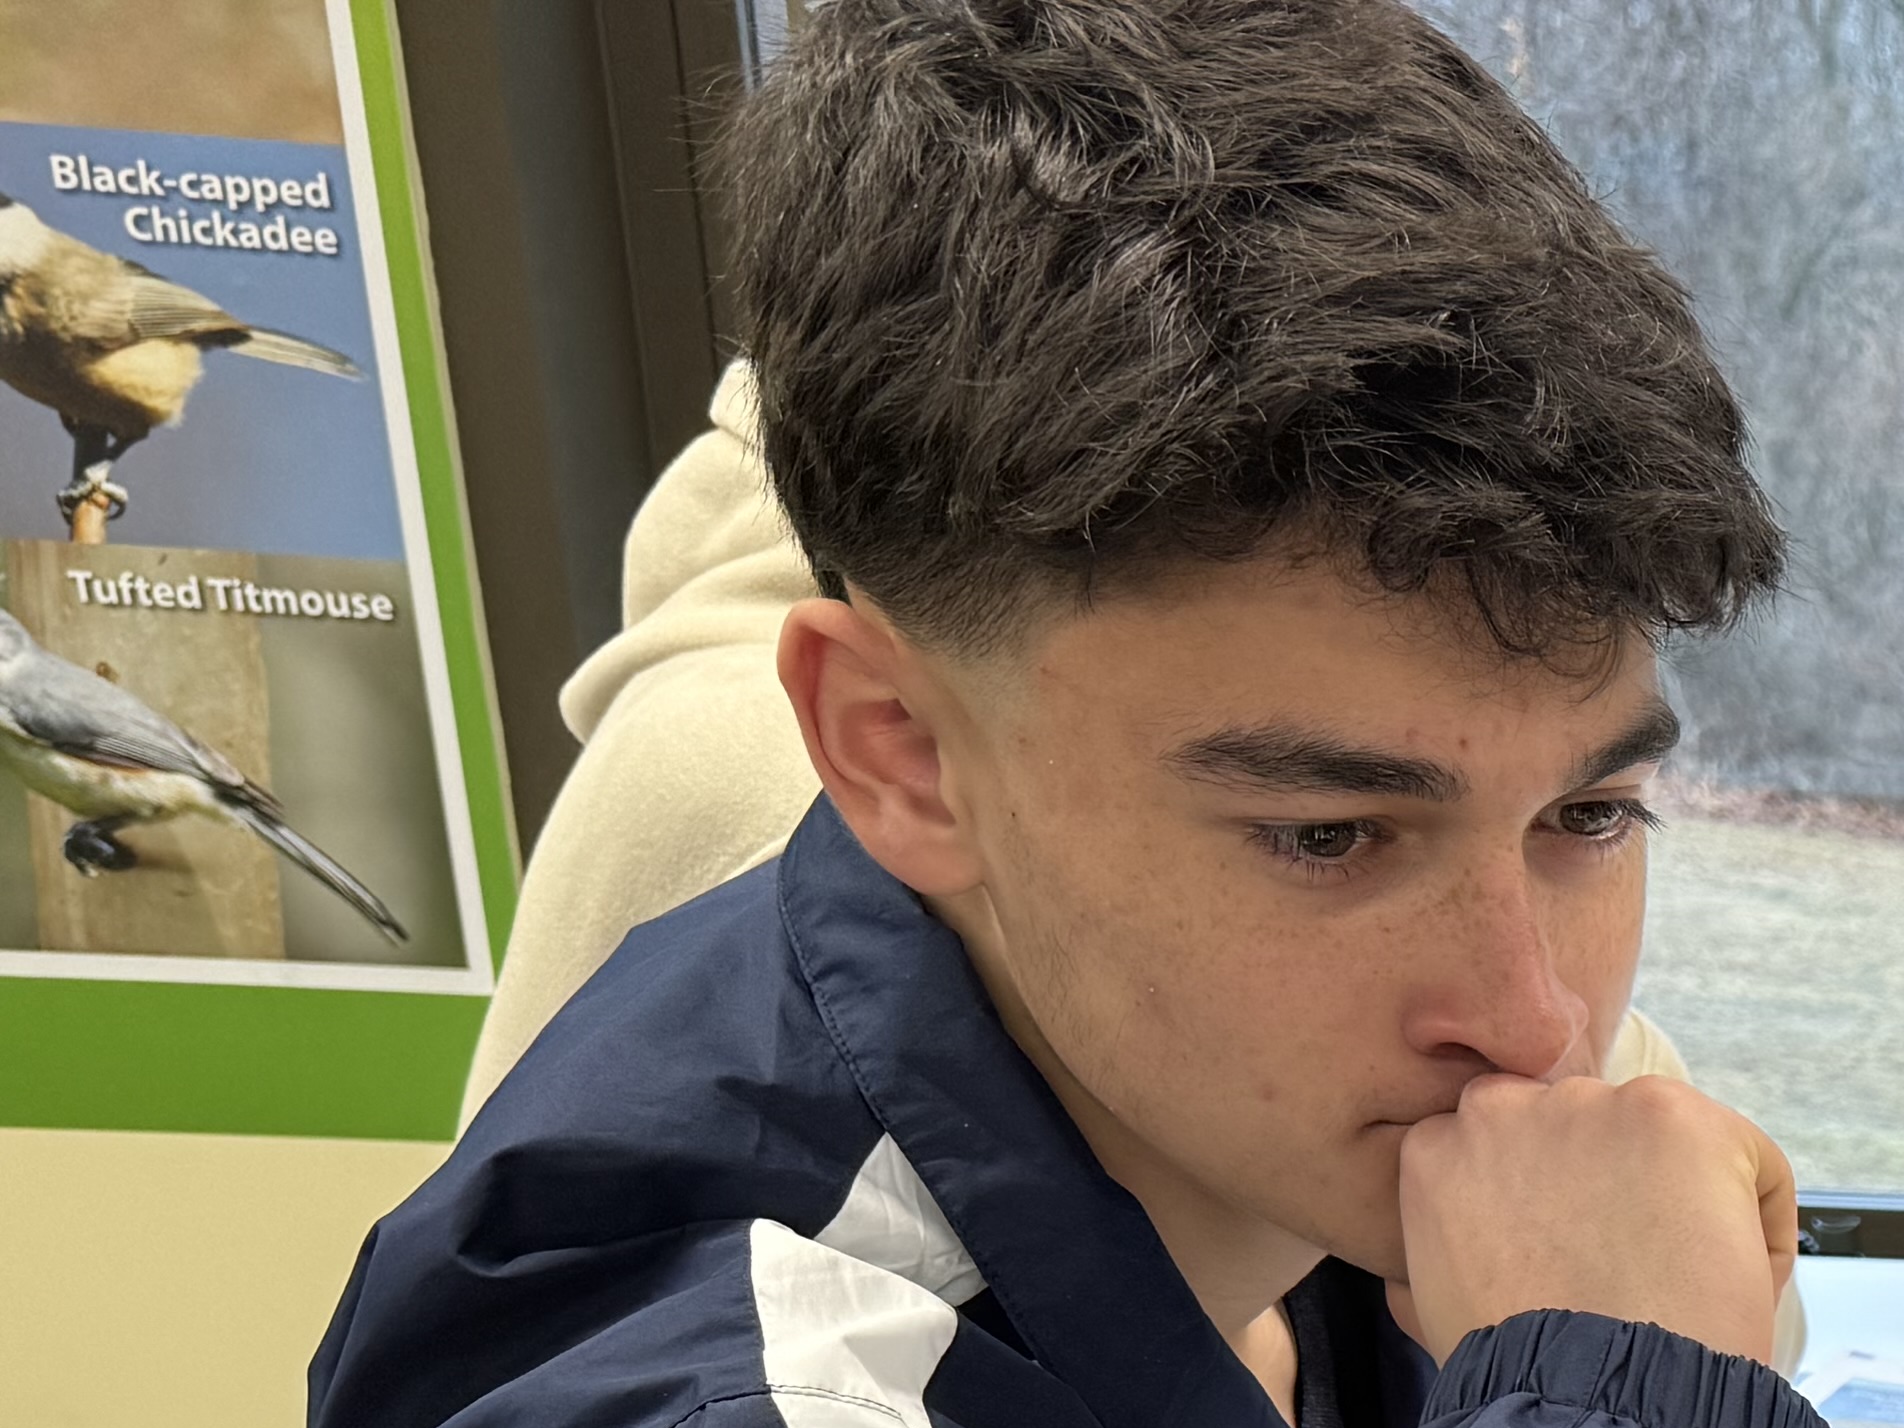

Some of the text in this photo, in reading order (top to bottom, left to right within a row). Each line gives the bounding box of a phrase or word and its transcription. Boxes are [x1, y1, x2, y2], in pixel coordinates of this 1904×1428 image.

[49, 153, 331, 212] Black-capped
[123, 205, 339, 255] Chickadee
[66, 569, 396, 621] Tufted Titmouse
